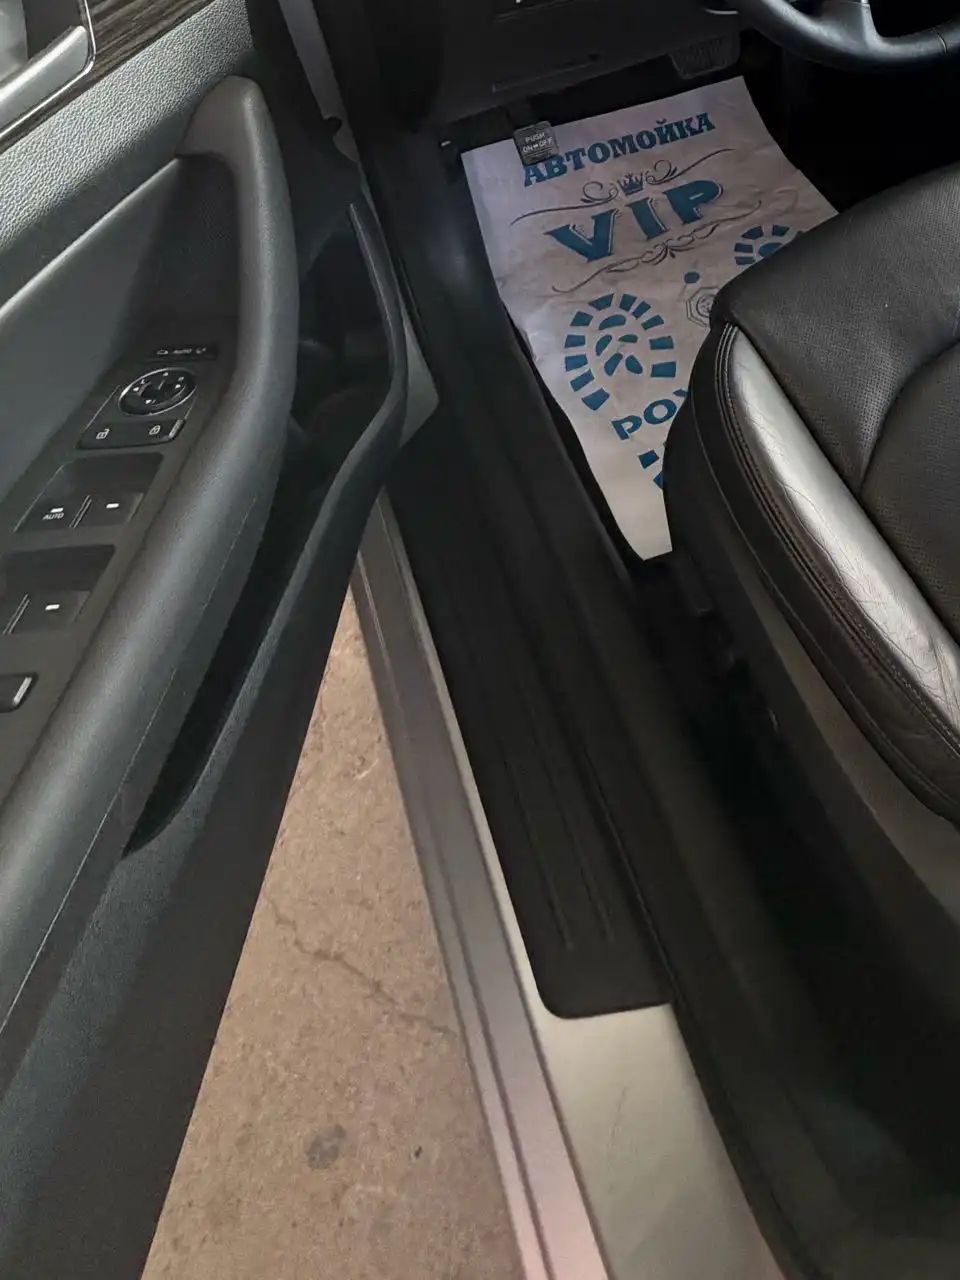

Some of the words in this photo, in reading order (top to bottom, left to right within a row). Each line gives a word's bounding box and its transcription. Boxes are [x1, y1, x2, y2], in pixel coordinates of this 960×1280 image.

[524, 112, 716, 187] АВТОМОЙКА
[546, 179, 724, 262] VIP
[42, 512, 65, 521] AUTO
